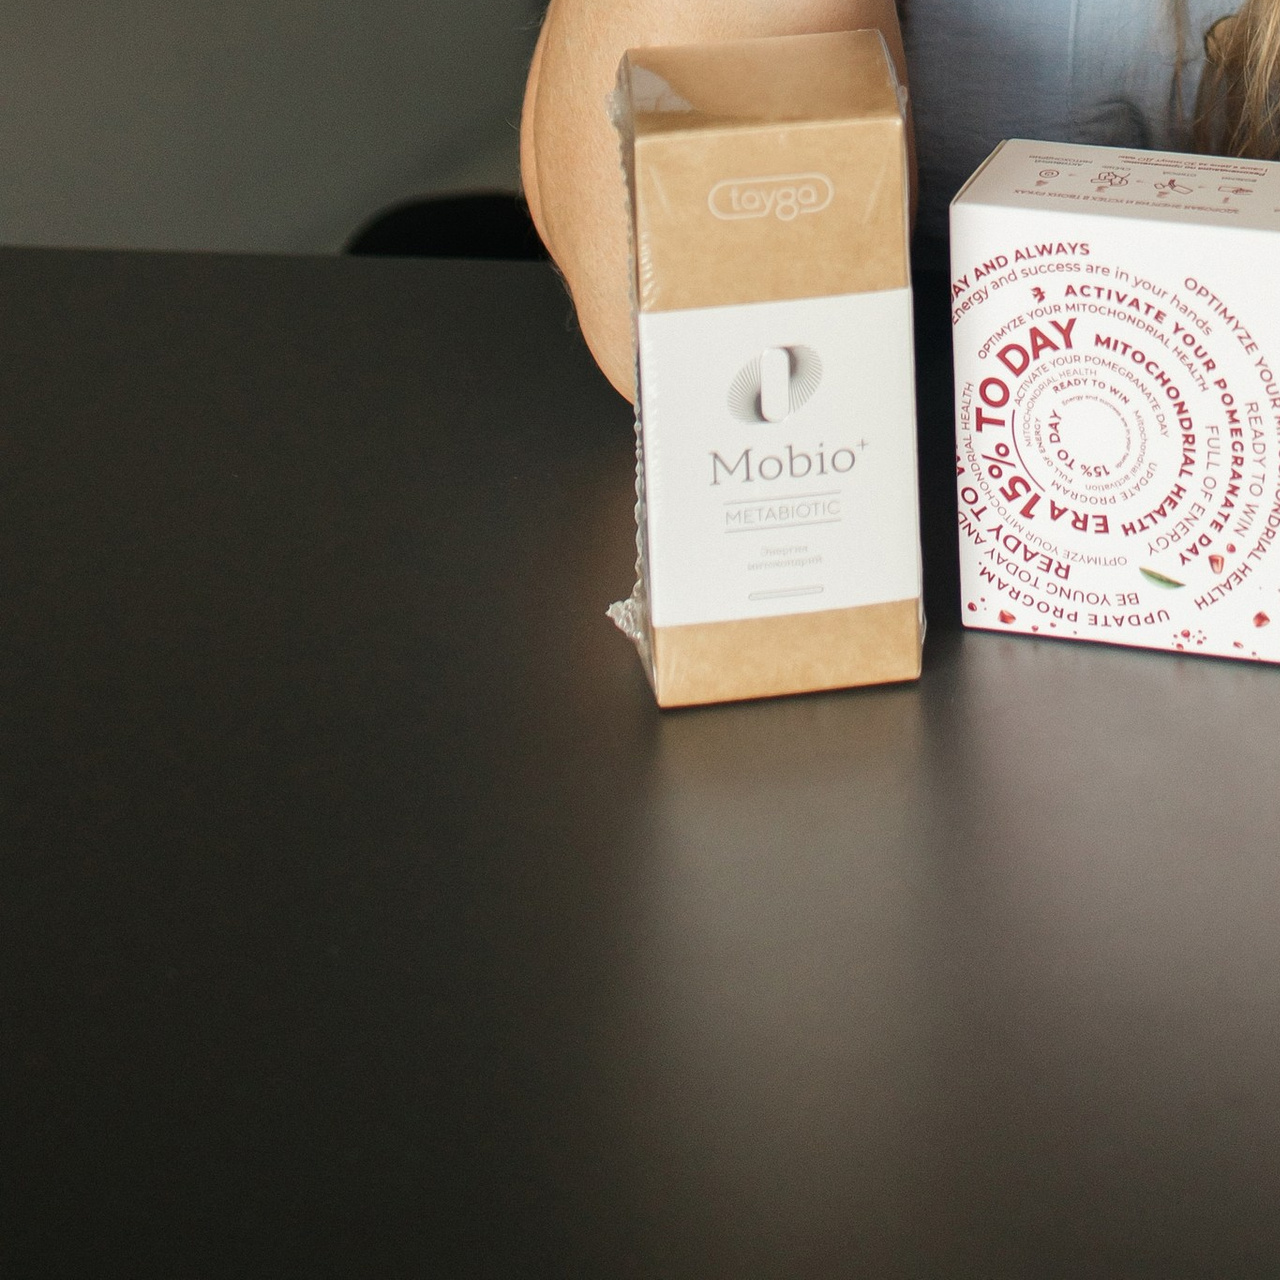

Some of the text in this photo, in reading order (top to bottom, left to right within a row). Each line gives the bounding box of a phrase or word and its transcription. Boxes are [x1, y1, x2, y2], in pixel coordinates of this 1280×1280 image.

[973, 255, 1009, 282] AND
[1013, 242, 1090, 262] ALWAYS
[952, 262, 1213, 336] Energy and success are in your hands
[1184, 277, 1259, 355] OPTIMYZE
[977, 303, 1209, 392] OPTIMYZE YOUR MITOCHONDRIAL HEALTH
[975, 317, 1109, 534] ERA 15% TO DAY
[1014, 355, 1169, 438] ACTIVATE YOUR POMEGRANATE DAY
[1022, 368, 1097, 447] MITOCHONDRIAL HEALTH
[1053, 378, 1130, 405] READY TO WIN
[1064, 284, 1245, 566] ACTIVATE YOUR POMEGRANATE DAY
[1034, 417, 1046, 453] ENERGY
[1048, 409, 1110, 477] 15% TO DAY
[1094, 333, 1196, 536] MITOCHONDRIAL HEALTH
[1233, 401, 1266, 538] READY TO WIN
[960, 381, 1128, 566] OPTIMYZE YOUR MITOCHONDRIAL HEALTH
[1051, 462, 1157, 505] UPDATE PROGRAM
[1055, 466, 1073, 484] FULL
[1147, 425, 1221, 556] FULL OF ENERGY
[725, 500, 841, 525] METABIOTIC
[961, 487, 1071, 580] READY TO
[984, 547, 1040, 590] TODAY
[1046, 582, 1112, 607] YOUNG
[1117, 592, 1140, 607] BE
[1194, 562, 1253, 610] HEALTH
[1088, 609, 1171, 628] UPDATE
